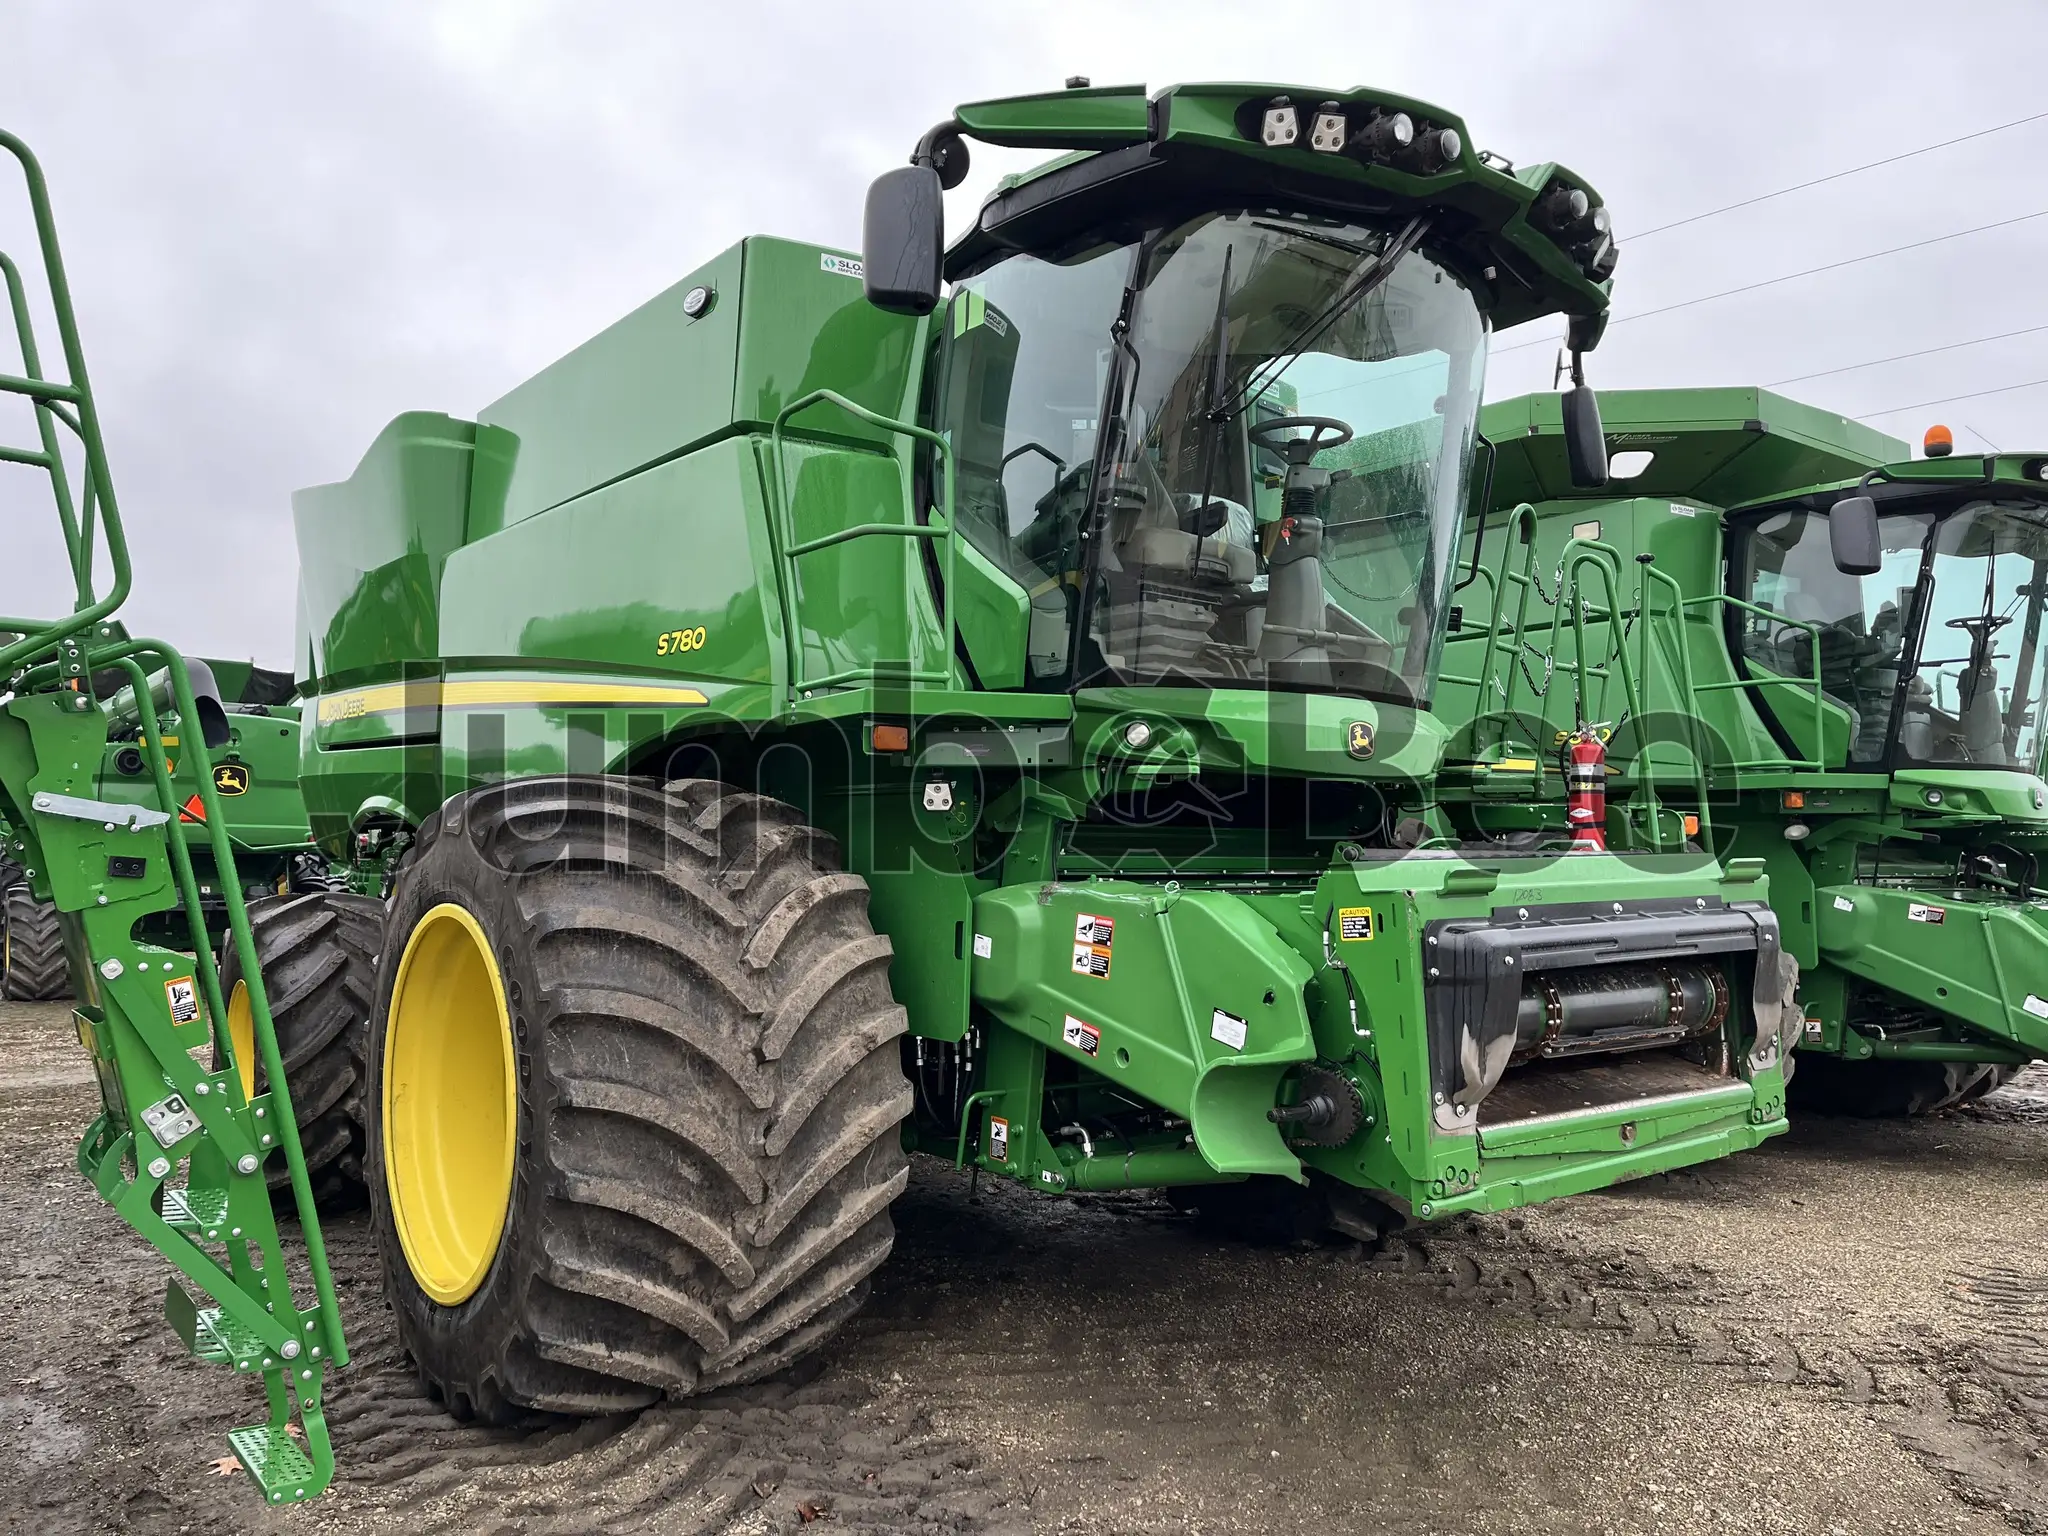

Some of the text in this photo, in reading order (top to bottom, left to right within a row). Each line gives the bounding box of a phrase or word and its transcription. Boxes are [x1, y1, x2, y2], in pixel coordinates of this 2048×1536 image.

[838, 260, 863, 272] SLO
[656, 624, 706, 656] S780
[326, 698, 366, 721] JOHN DEERE
